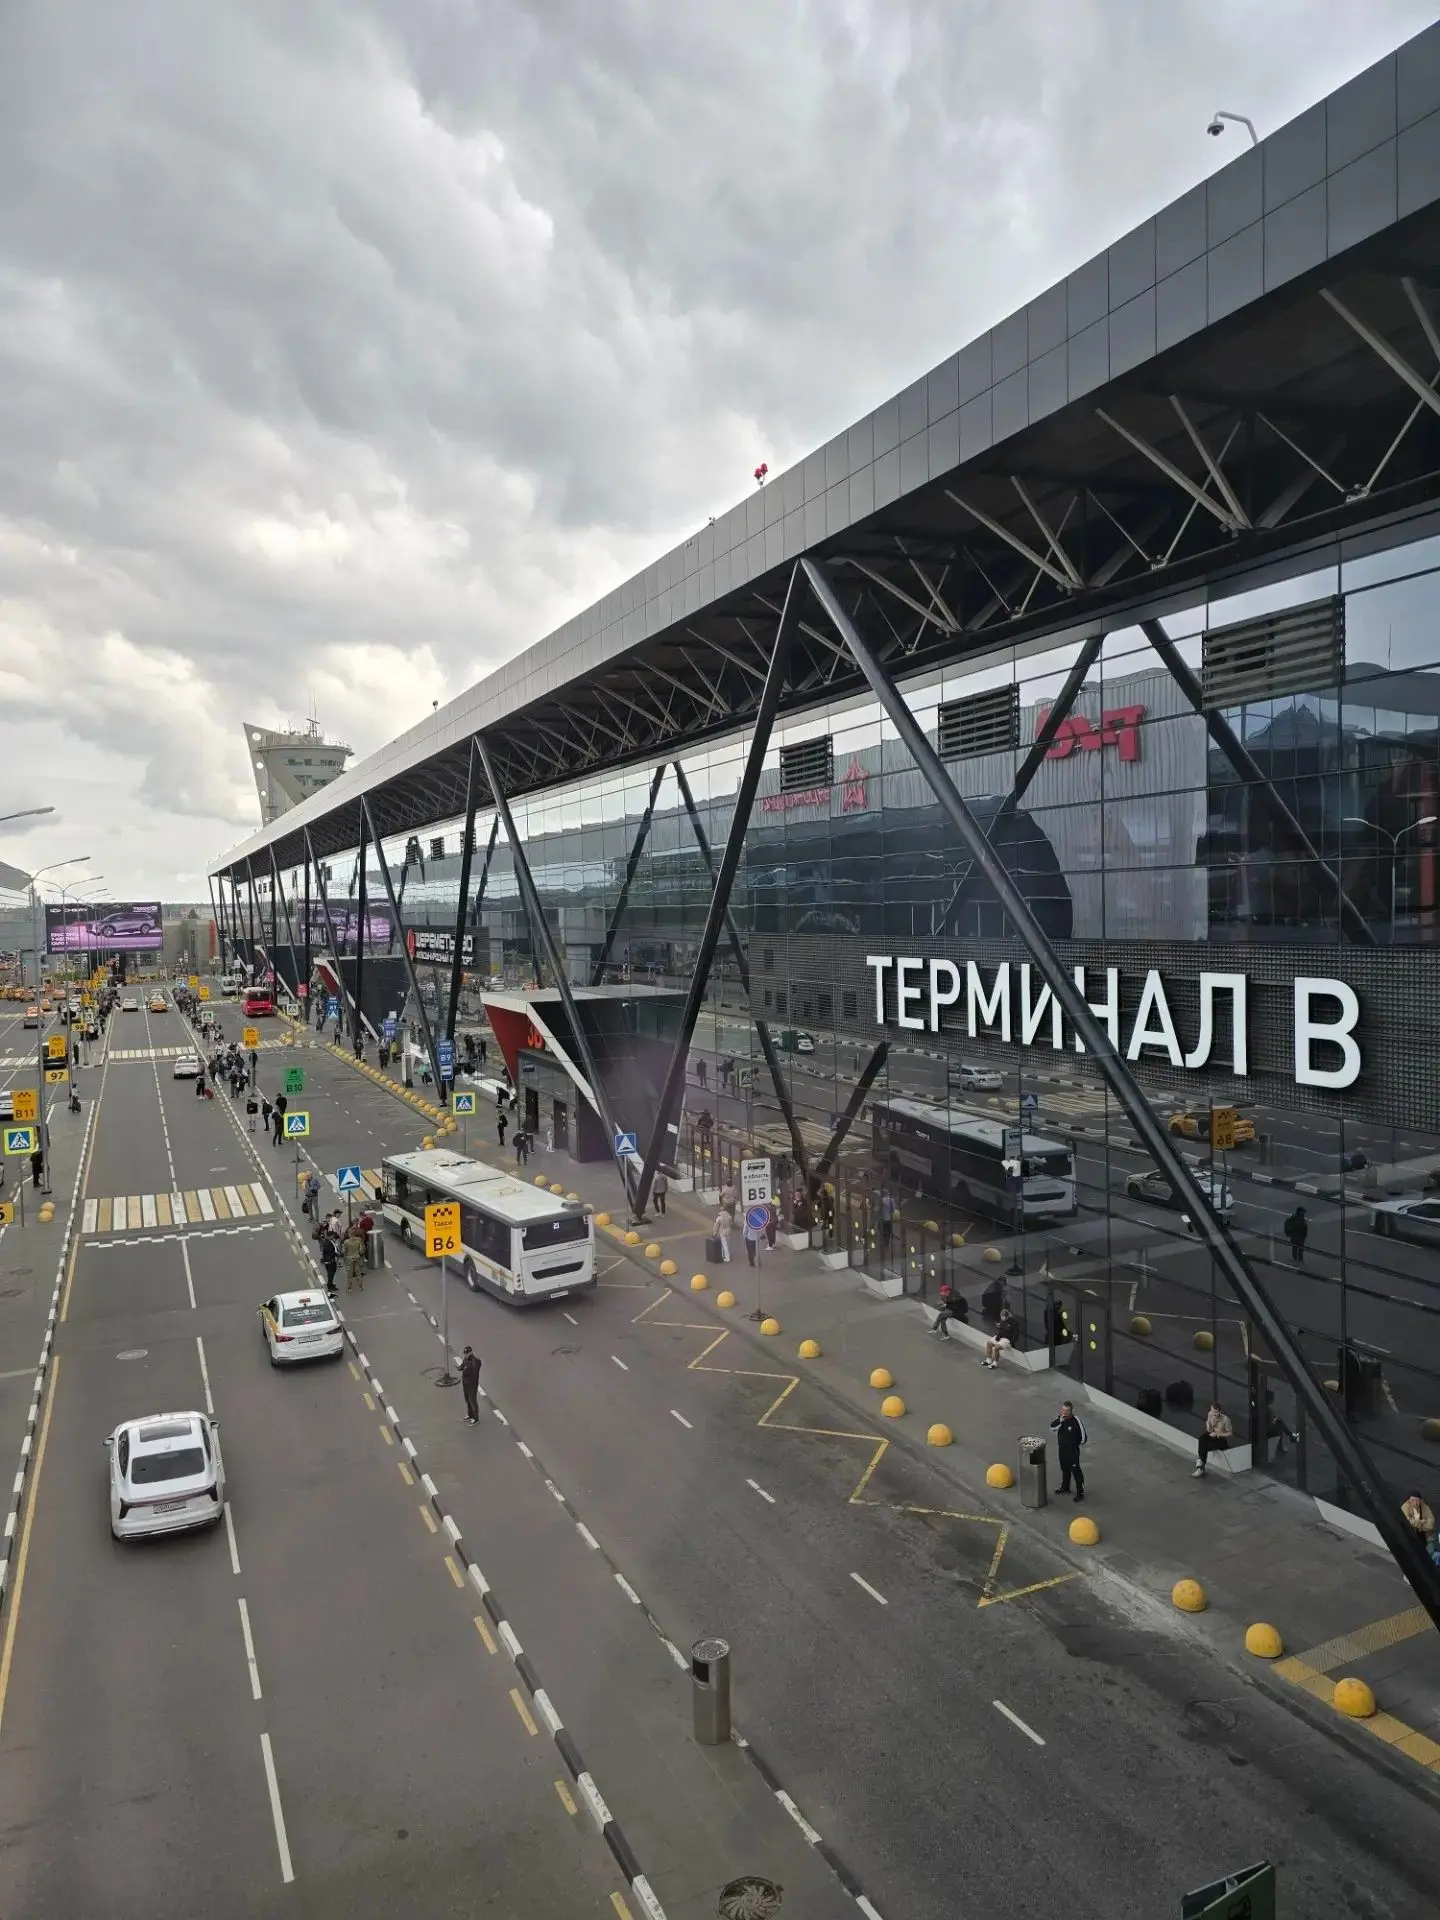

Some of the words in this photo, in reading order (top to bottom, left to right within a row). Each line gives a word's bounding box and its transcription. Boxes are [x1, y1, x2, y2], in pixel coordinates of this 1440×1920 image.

[866, 956, 1248, 1076] ТЕРМИНАЛ
[1294, 976, 1361, 1089] В
[51, 1071, 64, 1080] 97
[286, 1083, 303, 1092] B10
[15, 1109, 34, 1118] B11
[748, 1187, 766, 1201] B5
[433, 1236, 455, 1252] B6
